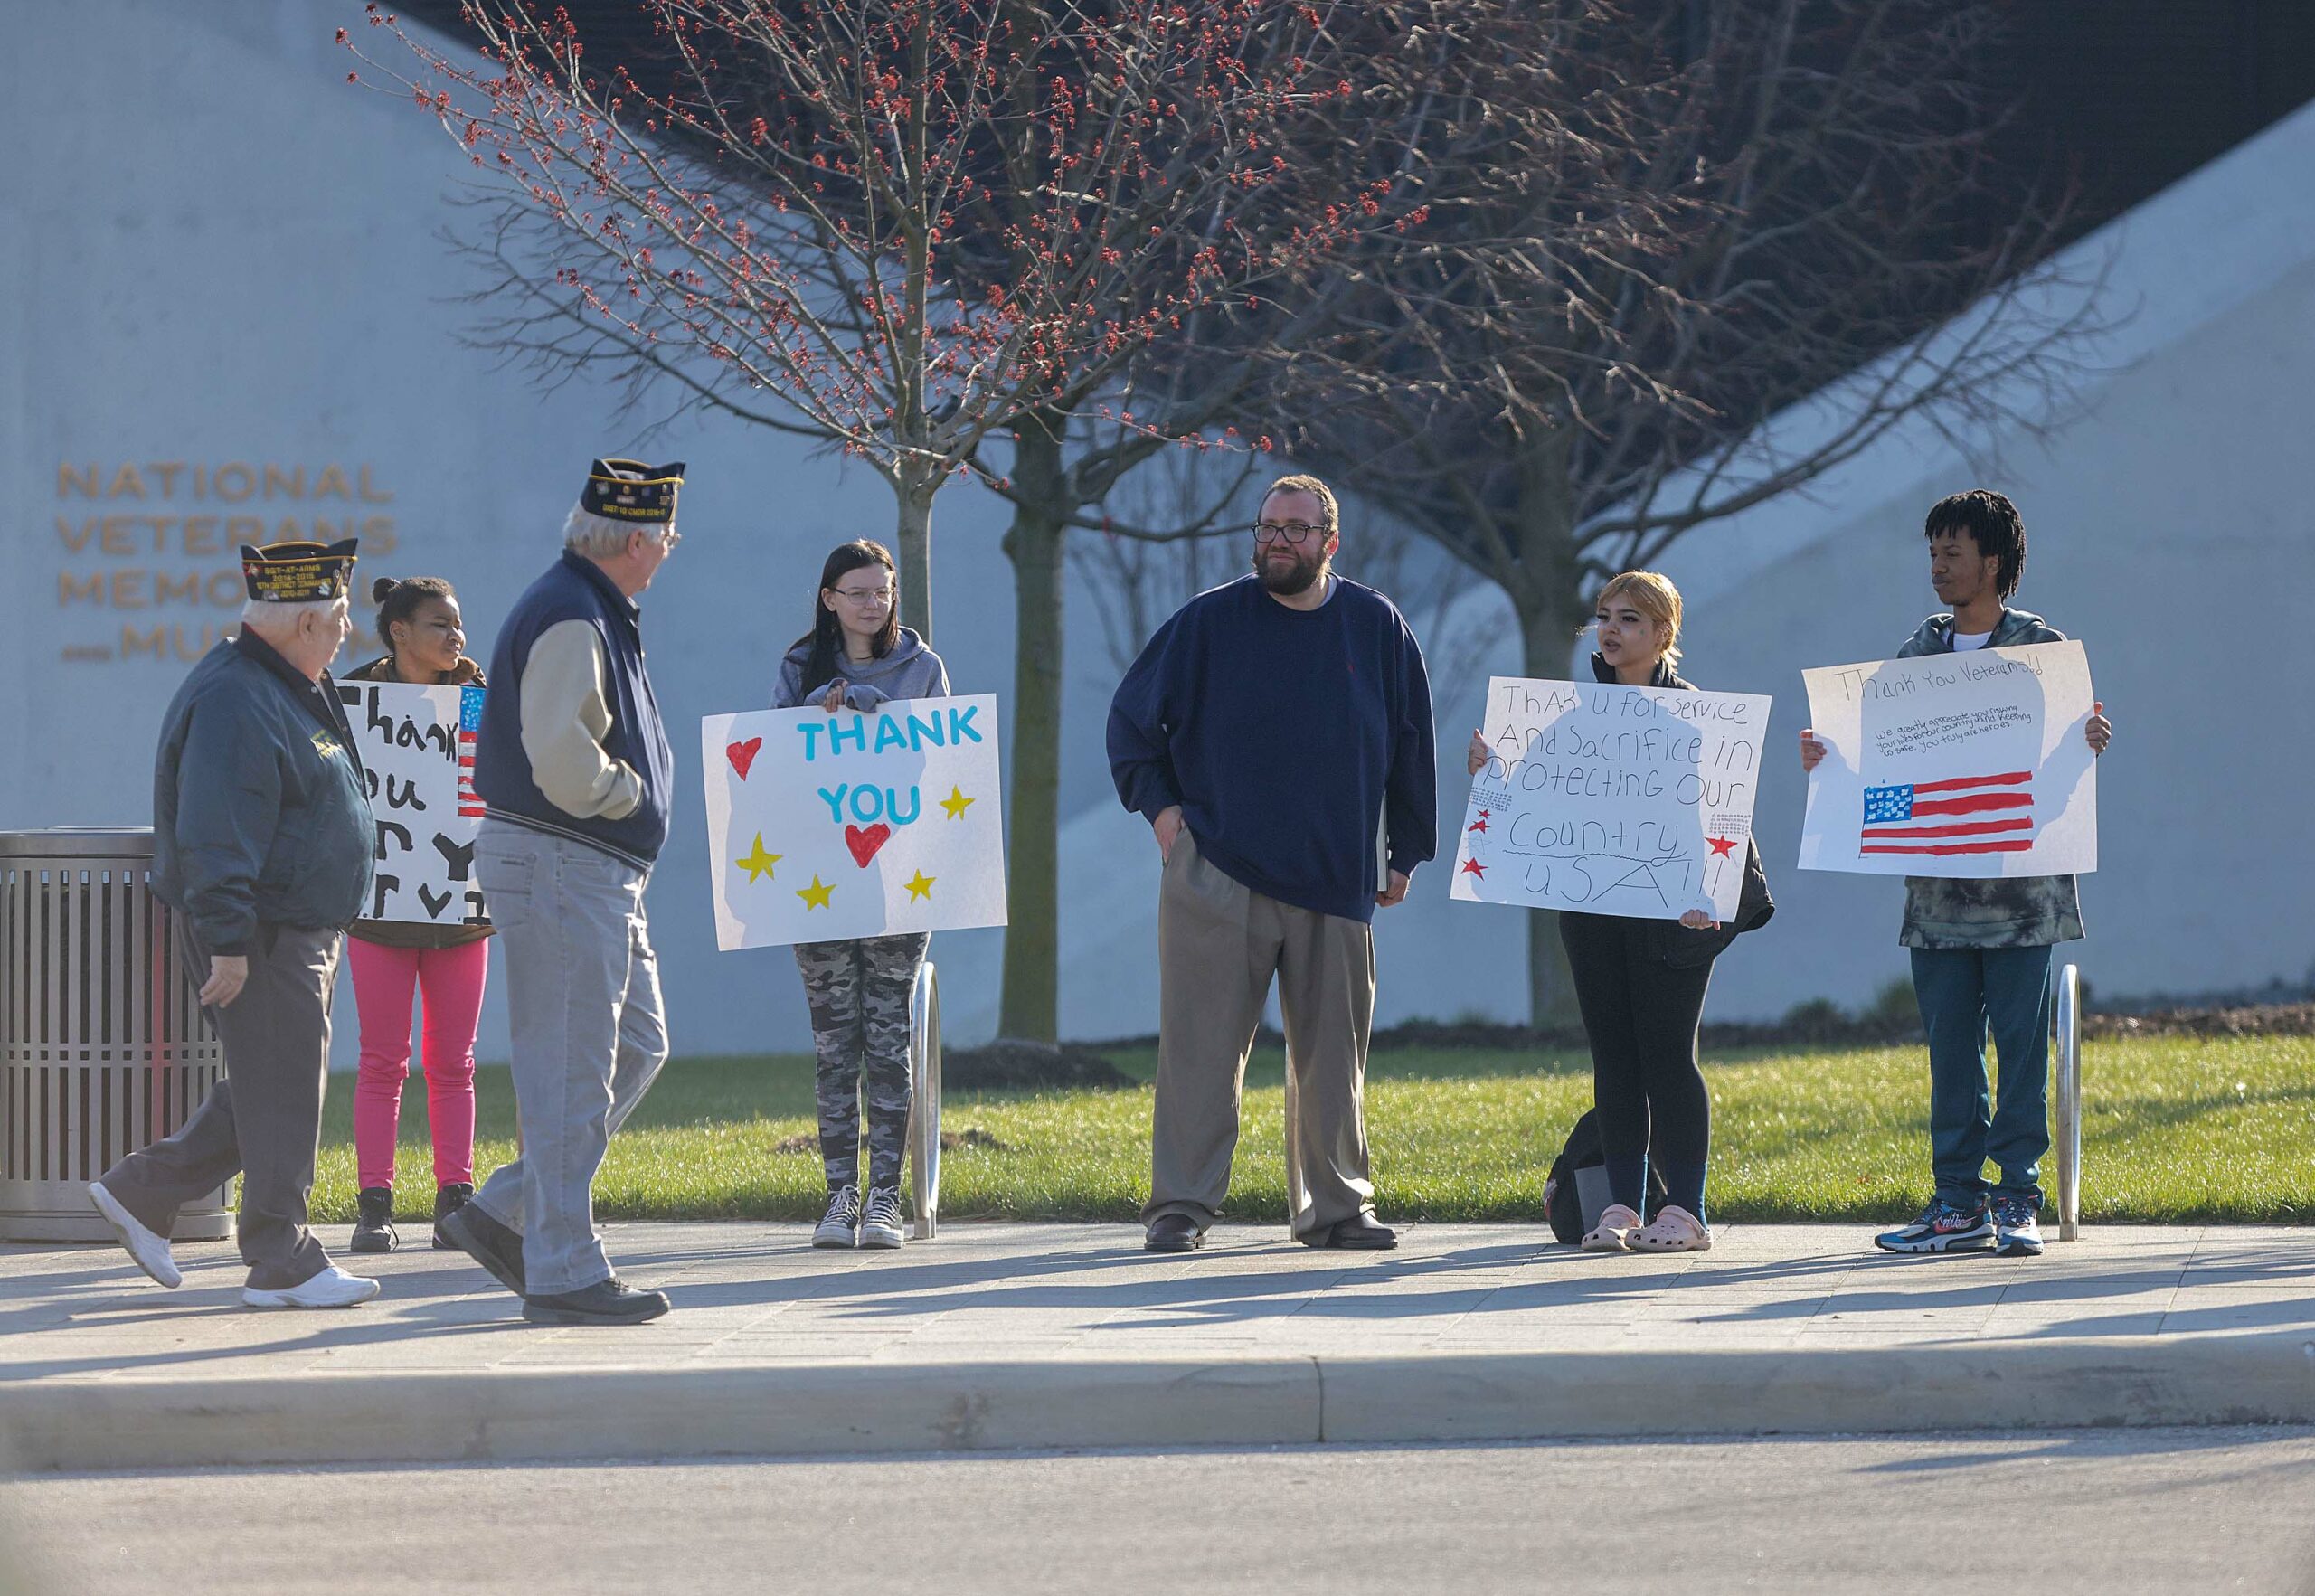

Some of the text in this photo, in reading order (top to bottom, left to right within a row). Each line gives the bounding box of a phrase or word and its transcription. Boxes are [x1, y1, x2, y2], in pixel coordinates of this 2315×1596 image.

[59, 462, 394, 499] NATIONAL
[1922, 671, 1956, 689] You
[796, 705, 982, 761] THANK
[1497, 723, 1753, 770] And Sacrifice in
[1875, 729, 1893, 740] We
[1897, 719, 1929, 738] greatly
[1876, 740, 1895, 753] your
[1964, 728, 1978, 737] are
[364, 768, 427, 811] ou
[817, 782, 920, 826] YOU
[1509, 812, 1687, 867] Country
